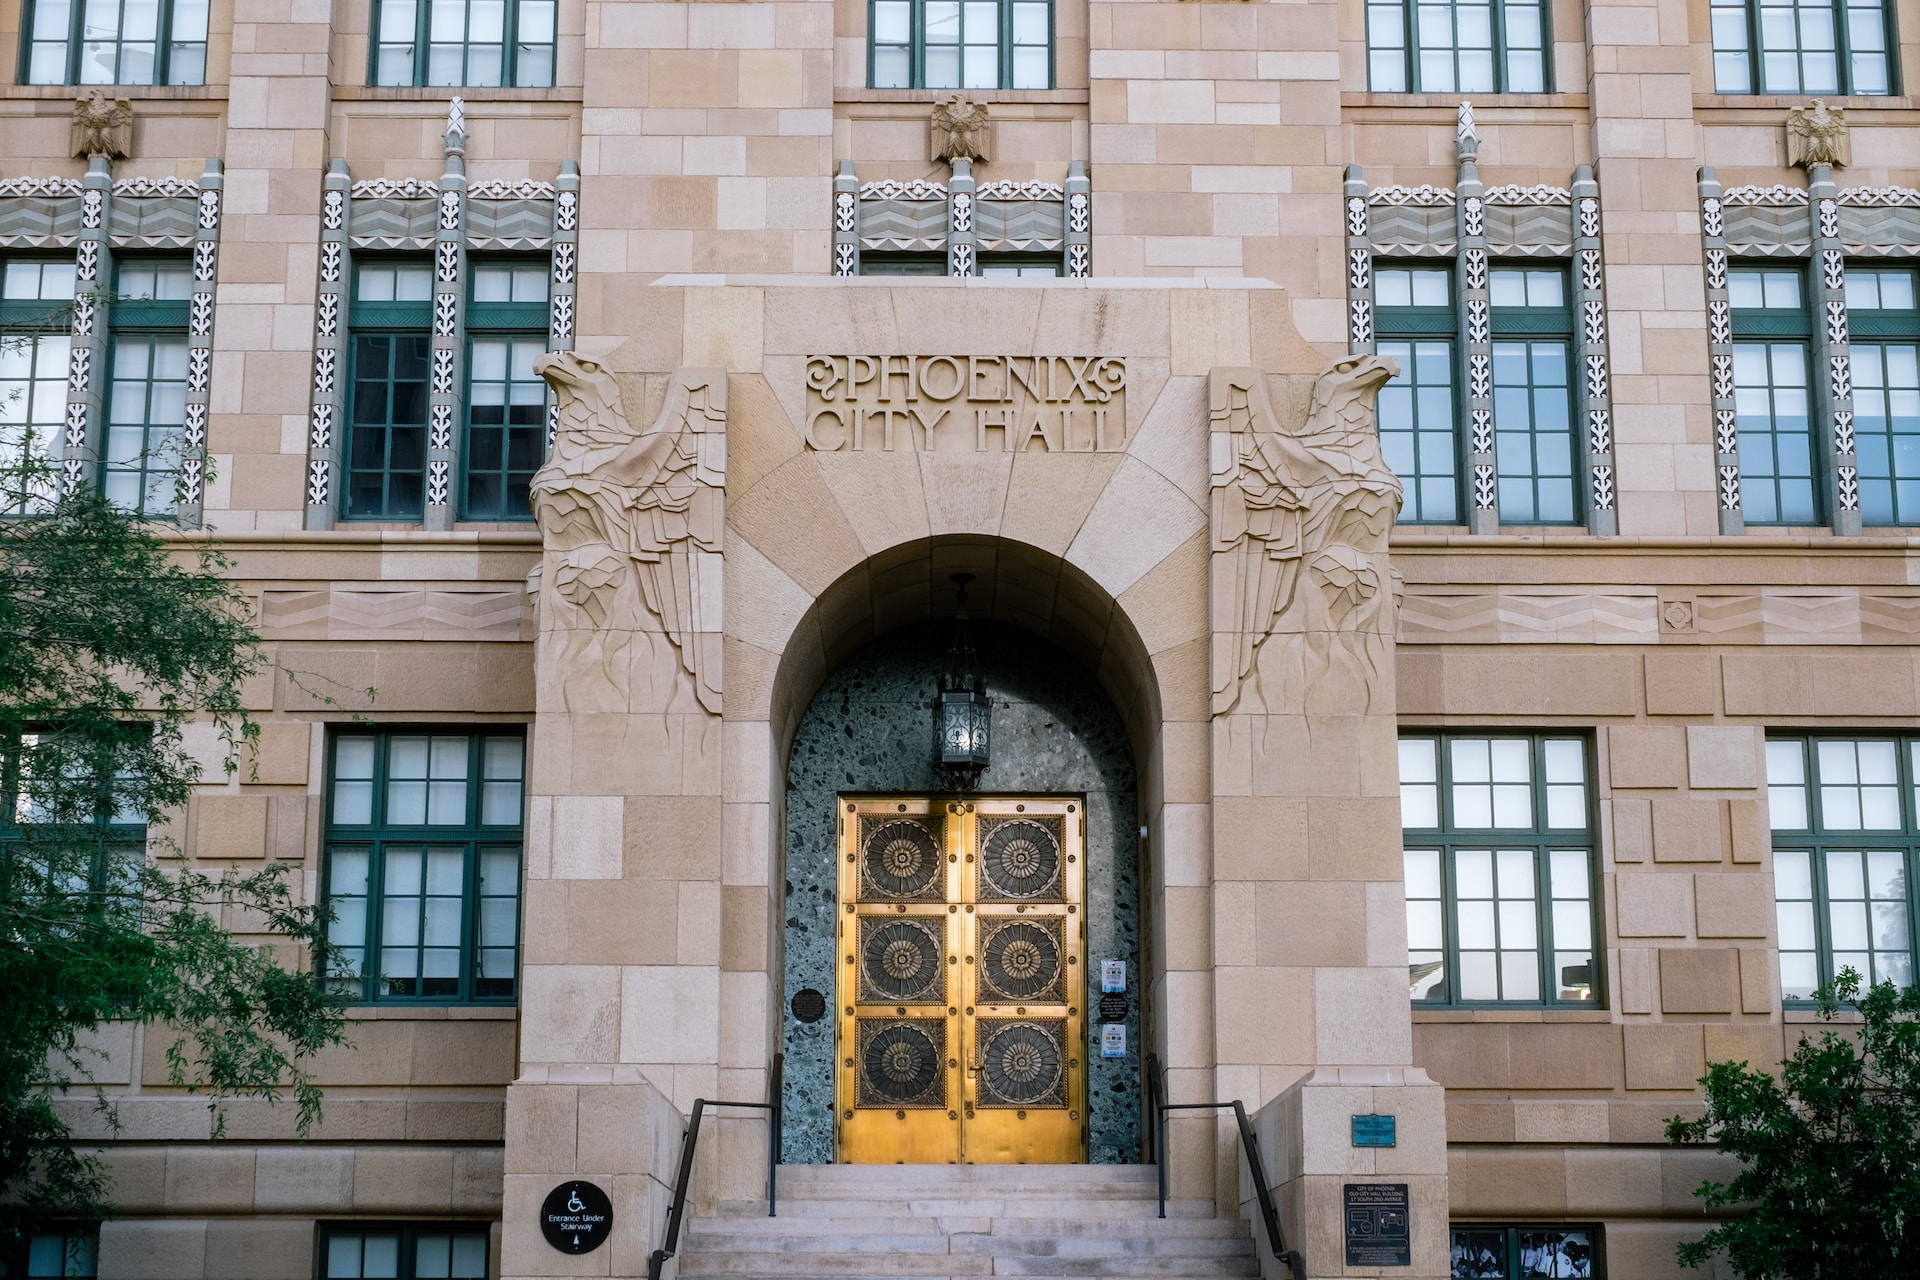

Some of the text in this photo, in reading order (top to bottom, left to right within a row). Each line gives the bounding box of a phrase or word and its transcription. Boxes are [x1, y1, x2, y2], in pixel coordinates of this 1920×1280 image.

[845, 355, 1097, 402] PHOENIX
[805, 408, 1126, 452] CITY HALL
[560, 1223, 592, 1231] Stairway
